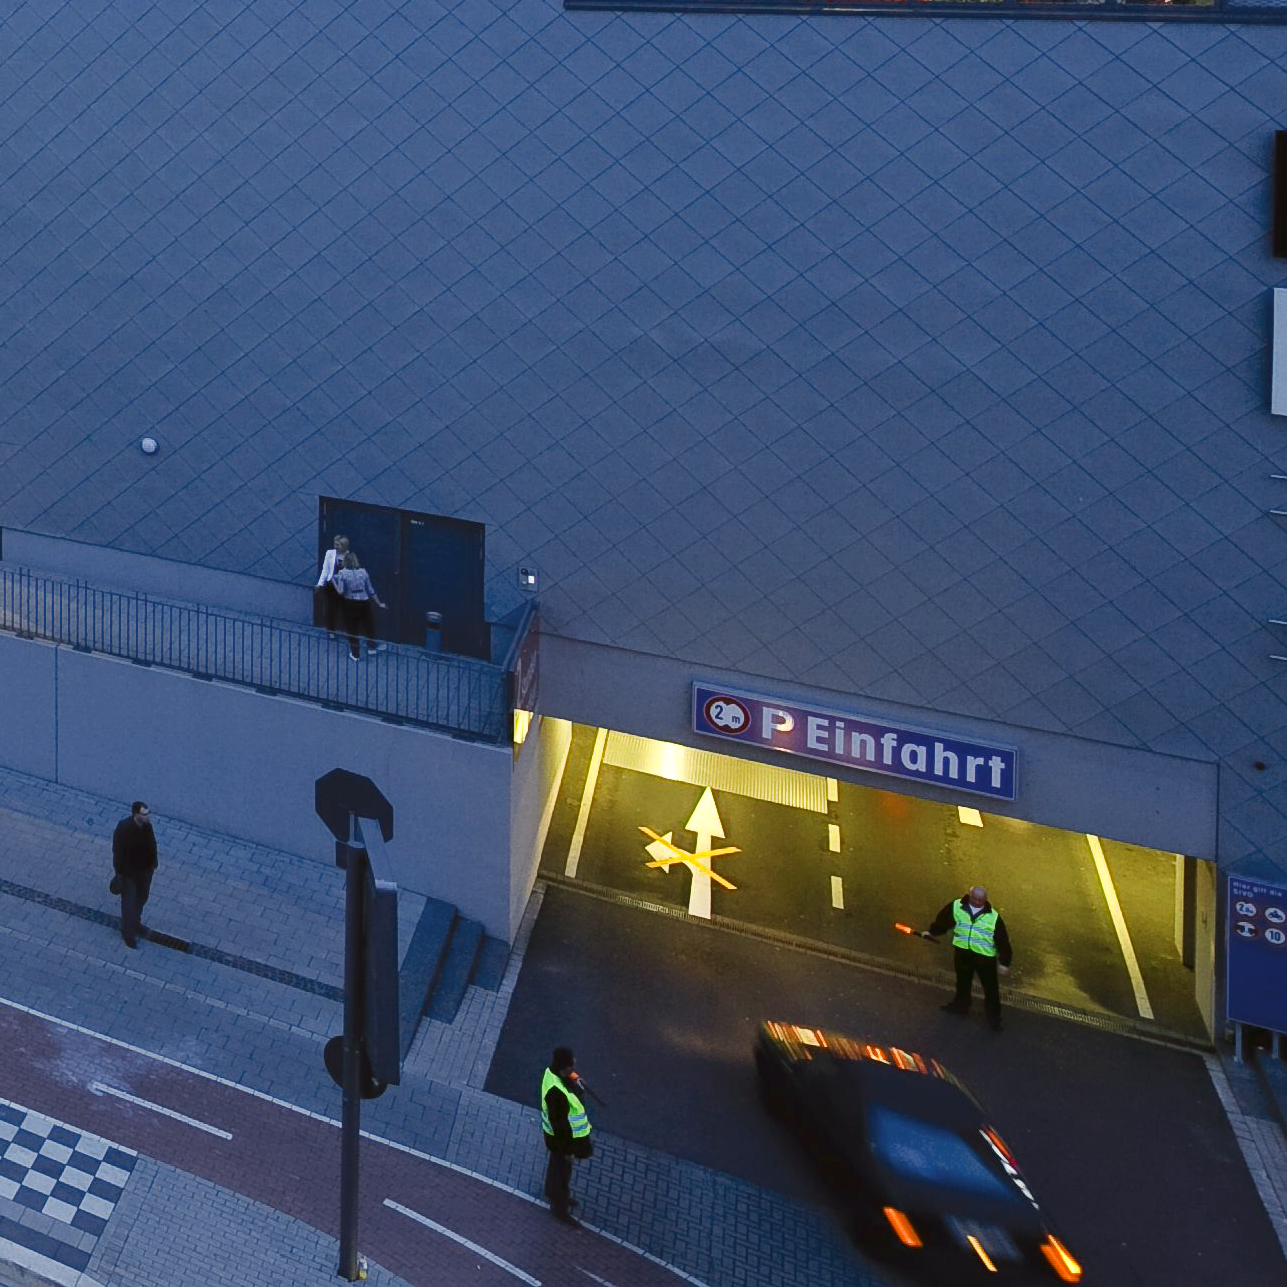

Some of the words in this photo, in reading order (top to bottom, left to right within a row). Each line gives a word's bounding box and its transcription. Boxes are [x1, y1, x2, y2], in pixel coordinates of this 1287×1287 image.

[714, 704, 724, 721] 2
[731, 715, 741, 725] m
[761, 706, 795, 740] P
[806, 716, 1005, 789] Einfahrt
[1268, 930, 1281, 942] 10
